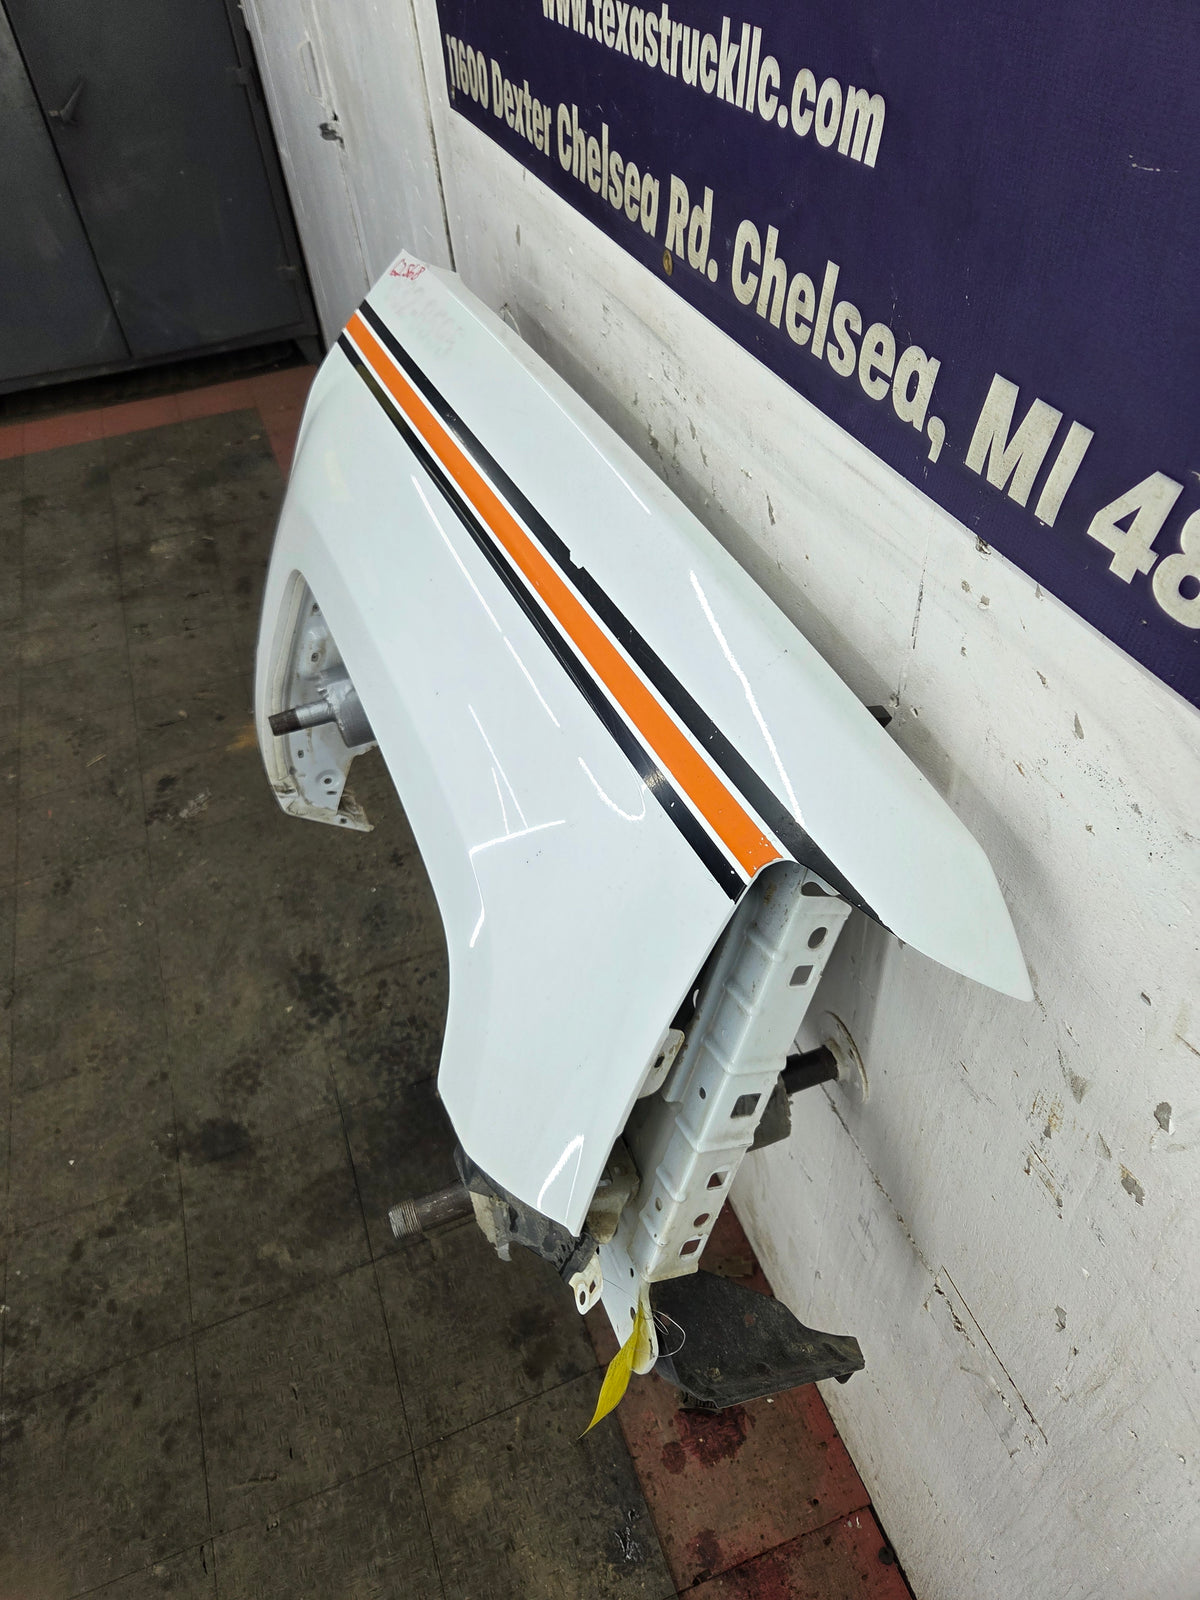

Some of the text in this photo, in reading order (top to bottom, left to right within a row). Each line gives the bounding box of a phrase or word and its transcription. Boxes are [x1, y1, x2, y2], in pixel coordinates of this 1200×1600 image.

[445, 34, 489, 109] 11600
[490, 59, 552, 157] Dexter
[557, 103, 659, 237] Chelsea
[665, 174, 719, 283] Rd.
[731, 219, 946, 464] Chelsea,
[965, 373, 1095, 528] MI
